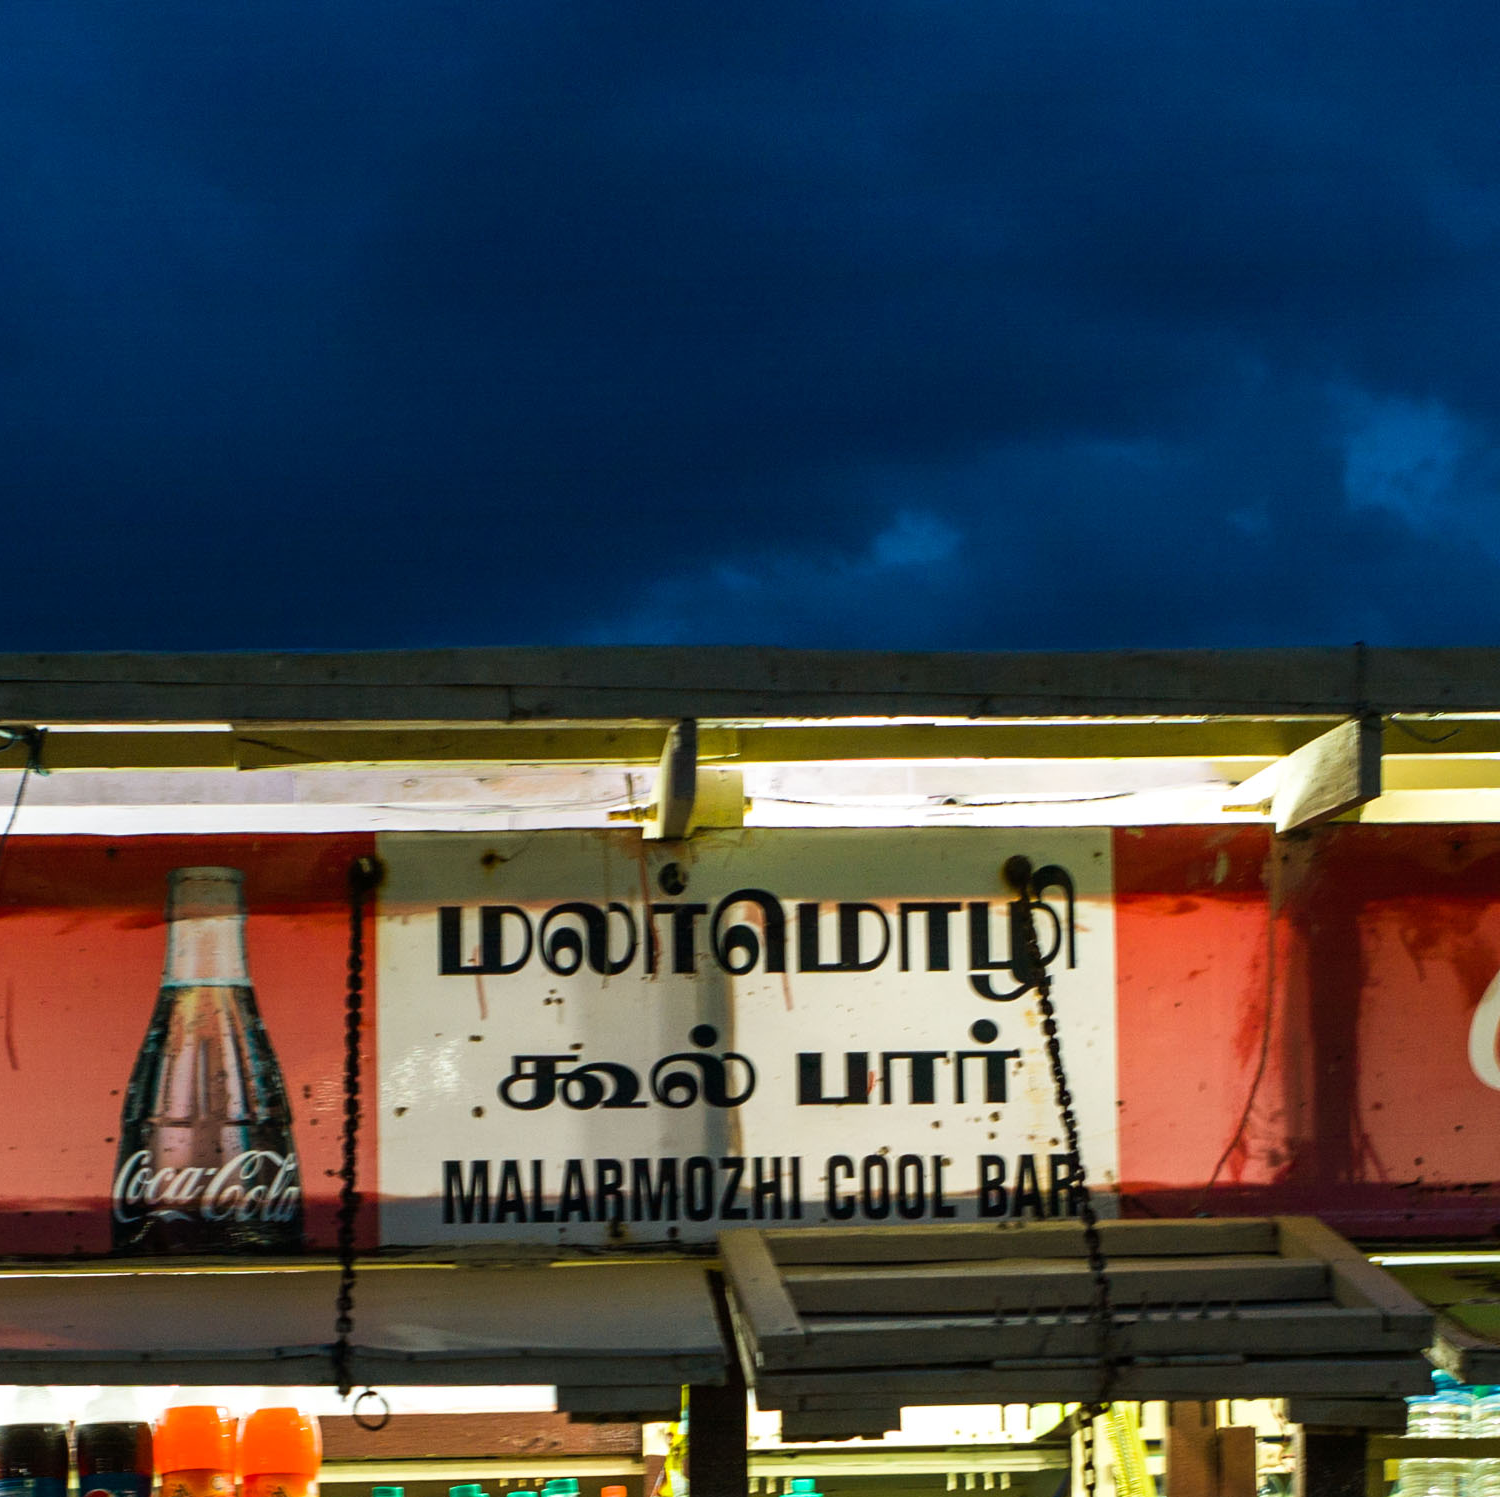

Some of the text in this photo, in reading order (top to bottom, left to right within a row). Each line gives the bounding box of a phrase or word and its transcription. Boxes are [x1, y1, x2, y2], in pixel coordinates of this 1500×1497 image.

[498, 1019, 1022, 1110] கூல் பார்
[113, 1149, 299, 1223] Coca-Cola
[443, 1153, 1082, 1224] MALARMOZHI COOL BAR
